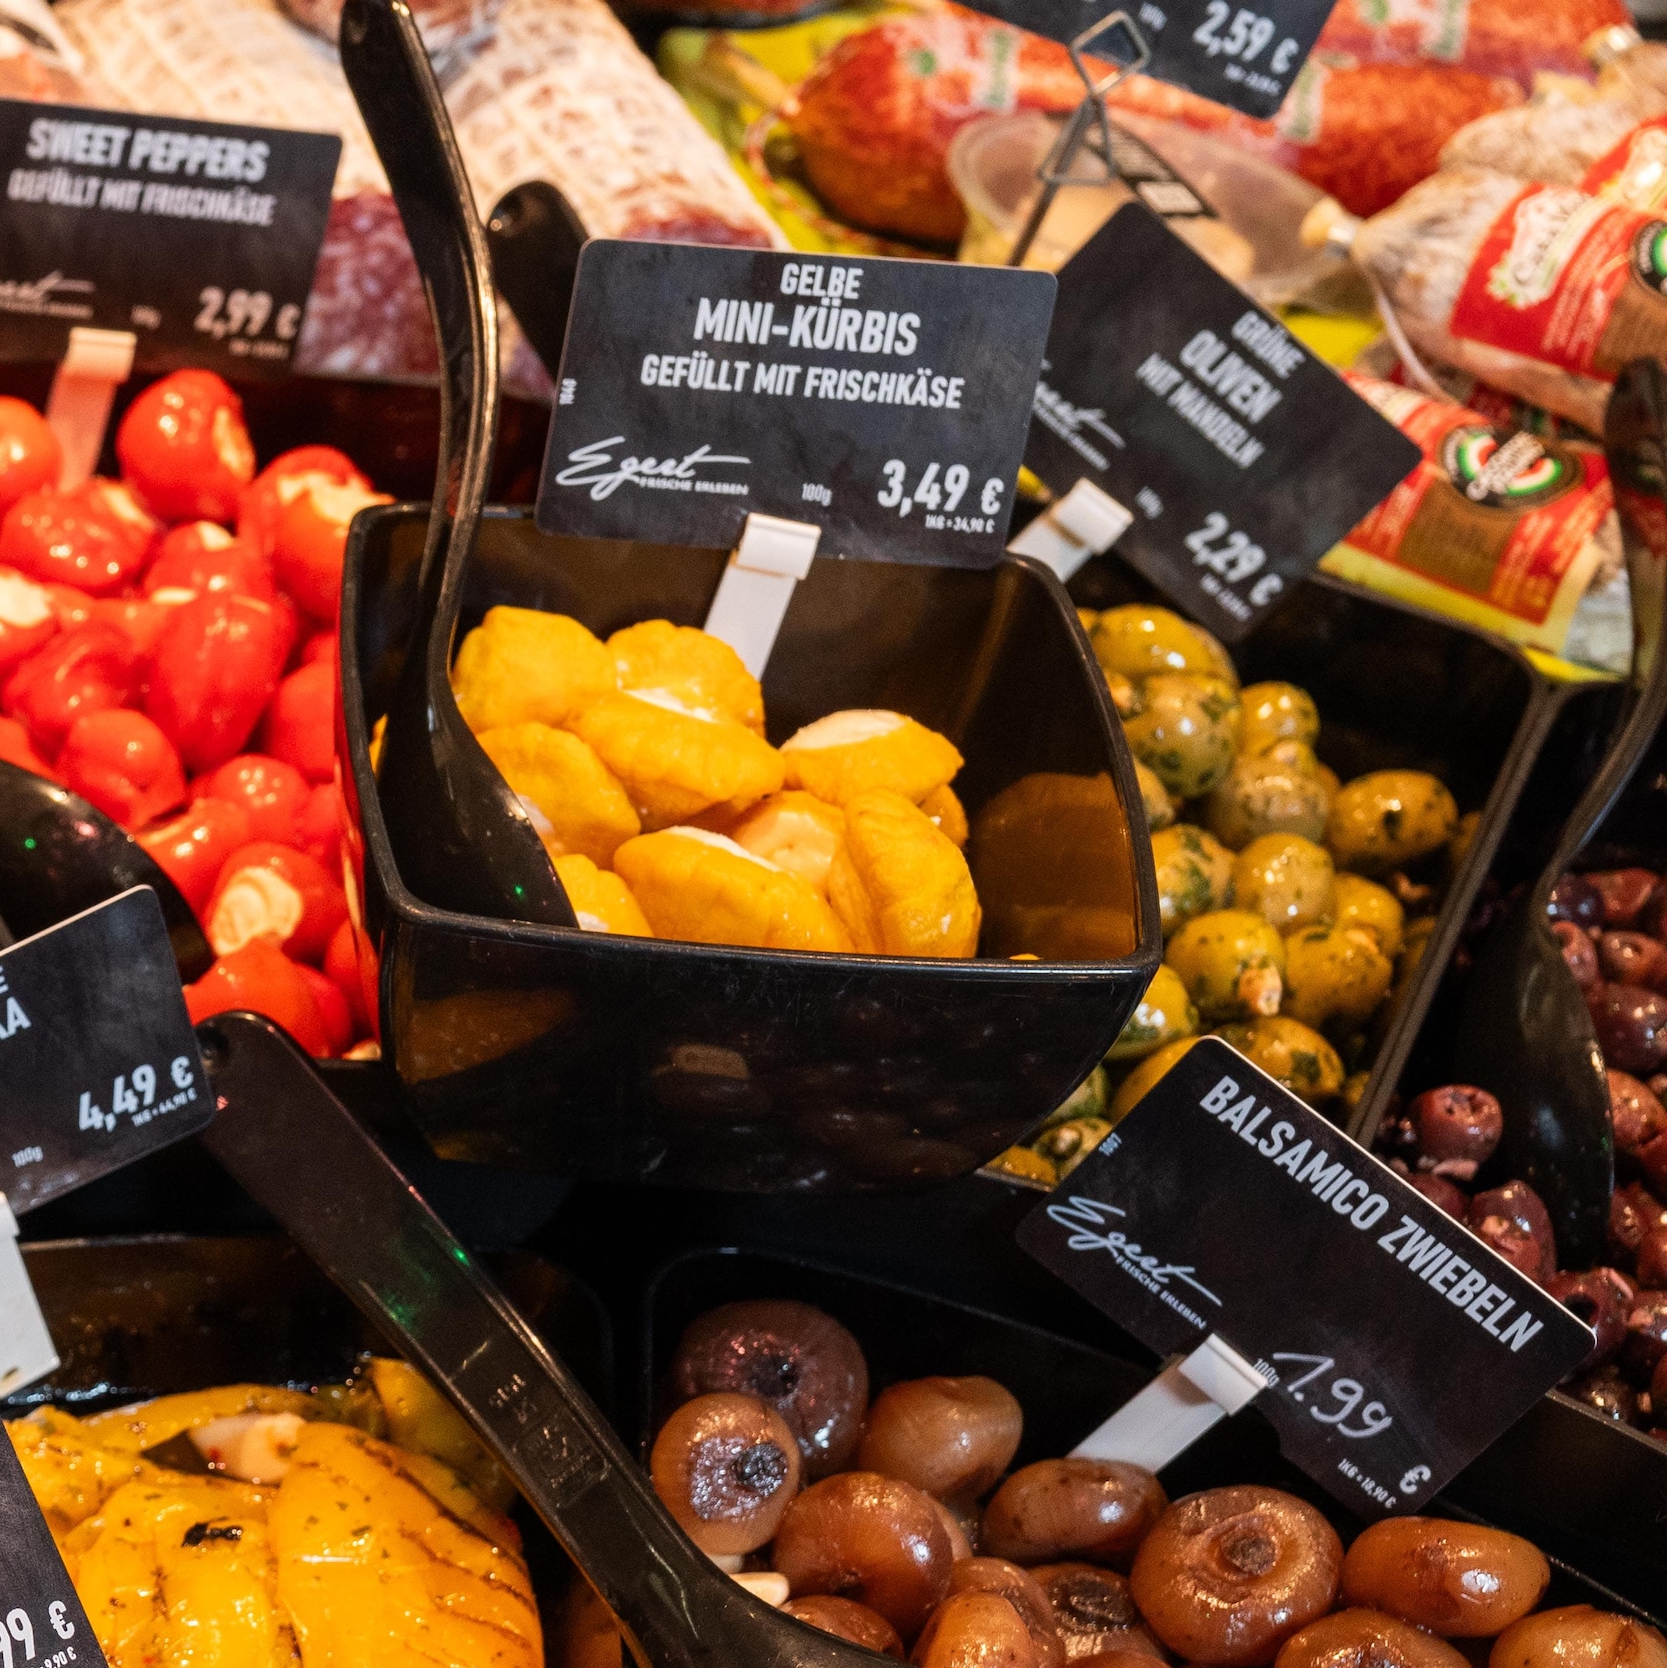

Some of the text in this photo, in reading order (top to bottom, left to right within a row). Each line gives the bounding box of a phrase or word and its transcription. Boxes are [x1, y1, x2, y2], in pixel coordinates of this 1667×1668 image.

[1193, 0, 1275, 68] 2,59
[1271, 38, 1299, 74] €
[27, 119, 269, 181] SWEET PEPPERS
[780, 263, 864, 299] GELBE
[195, 287, 272, 338] 2,99
[692, 297, 921, 356] MINI-KÜRBIS
[640, 350, 966, 410] GEFÜLLT MIT FRISCHKÄSE
[1181, 331, 1281, 422] OLIVEN
[800, 482, 834, 507] 100g
[877, 459, 1005, 523] 3,49 €
[1185, 512, 1266, 596] 2,29
[78, 1056, 194, 1132] 4,49 €
[11, 1143, 44, 1170] 100g
[1200, 1075, 1544, 1352] BALSAMICO ZWIEBELN
[1113, 1254, 1209, 1330] FRISCHE ERLEBEN
[1399, 1465, 1431, 1494] €
[48, 1600, 75, 1640] €
[66, 1646, 77, 1660] €
